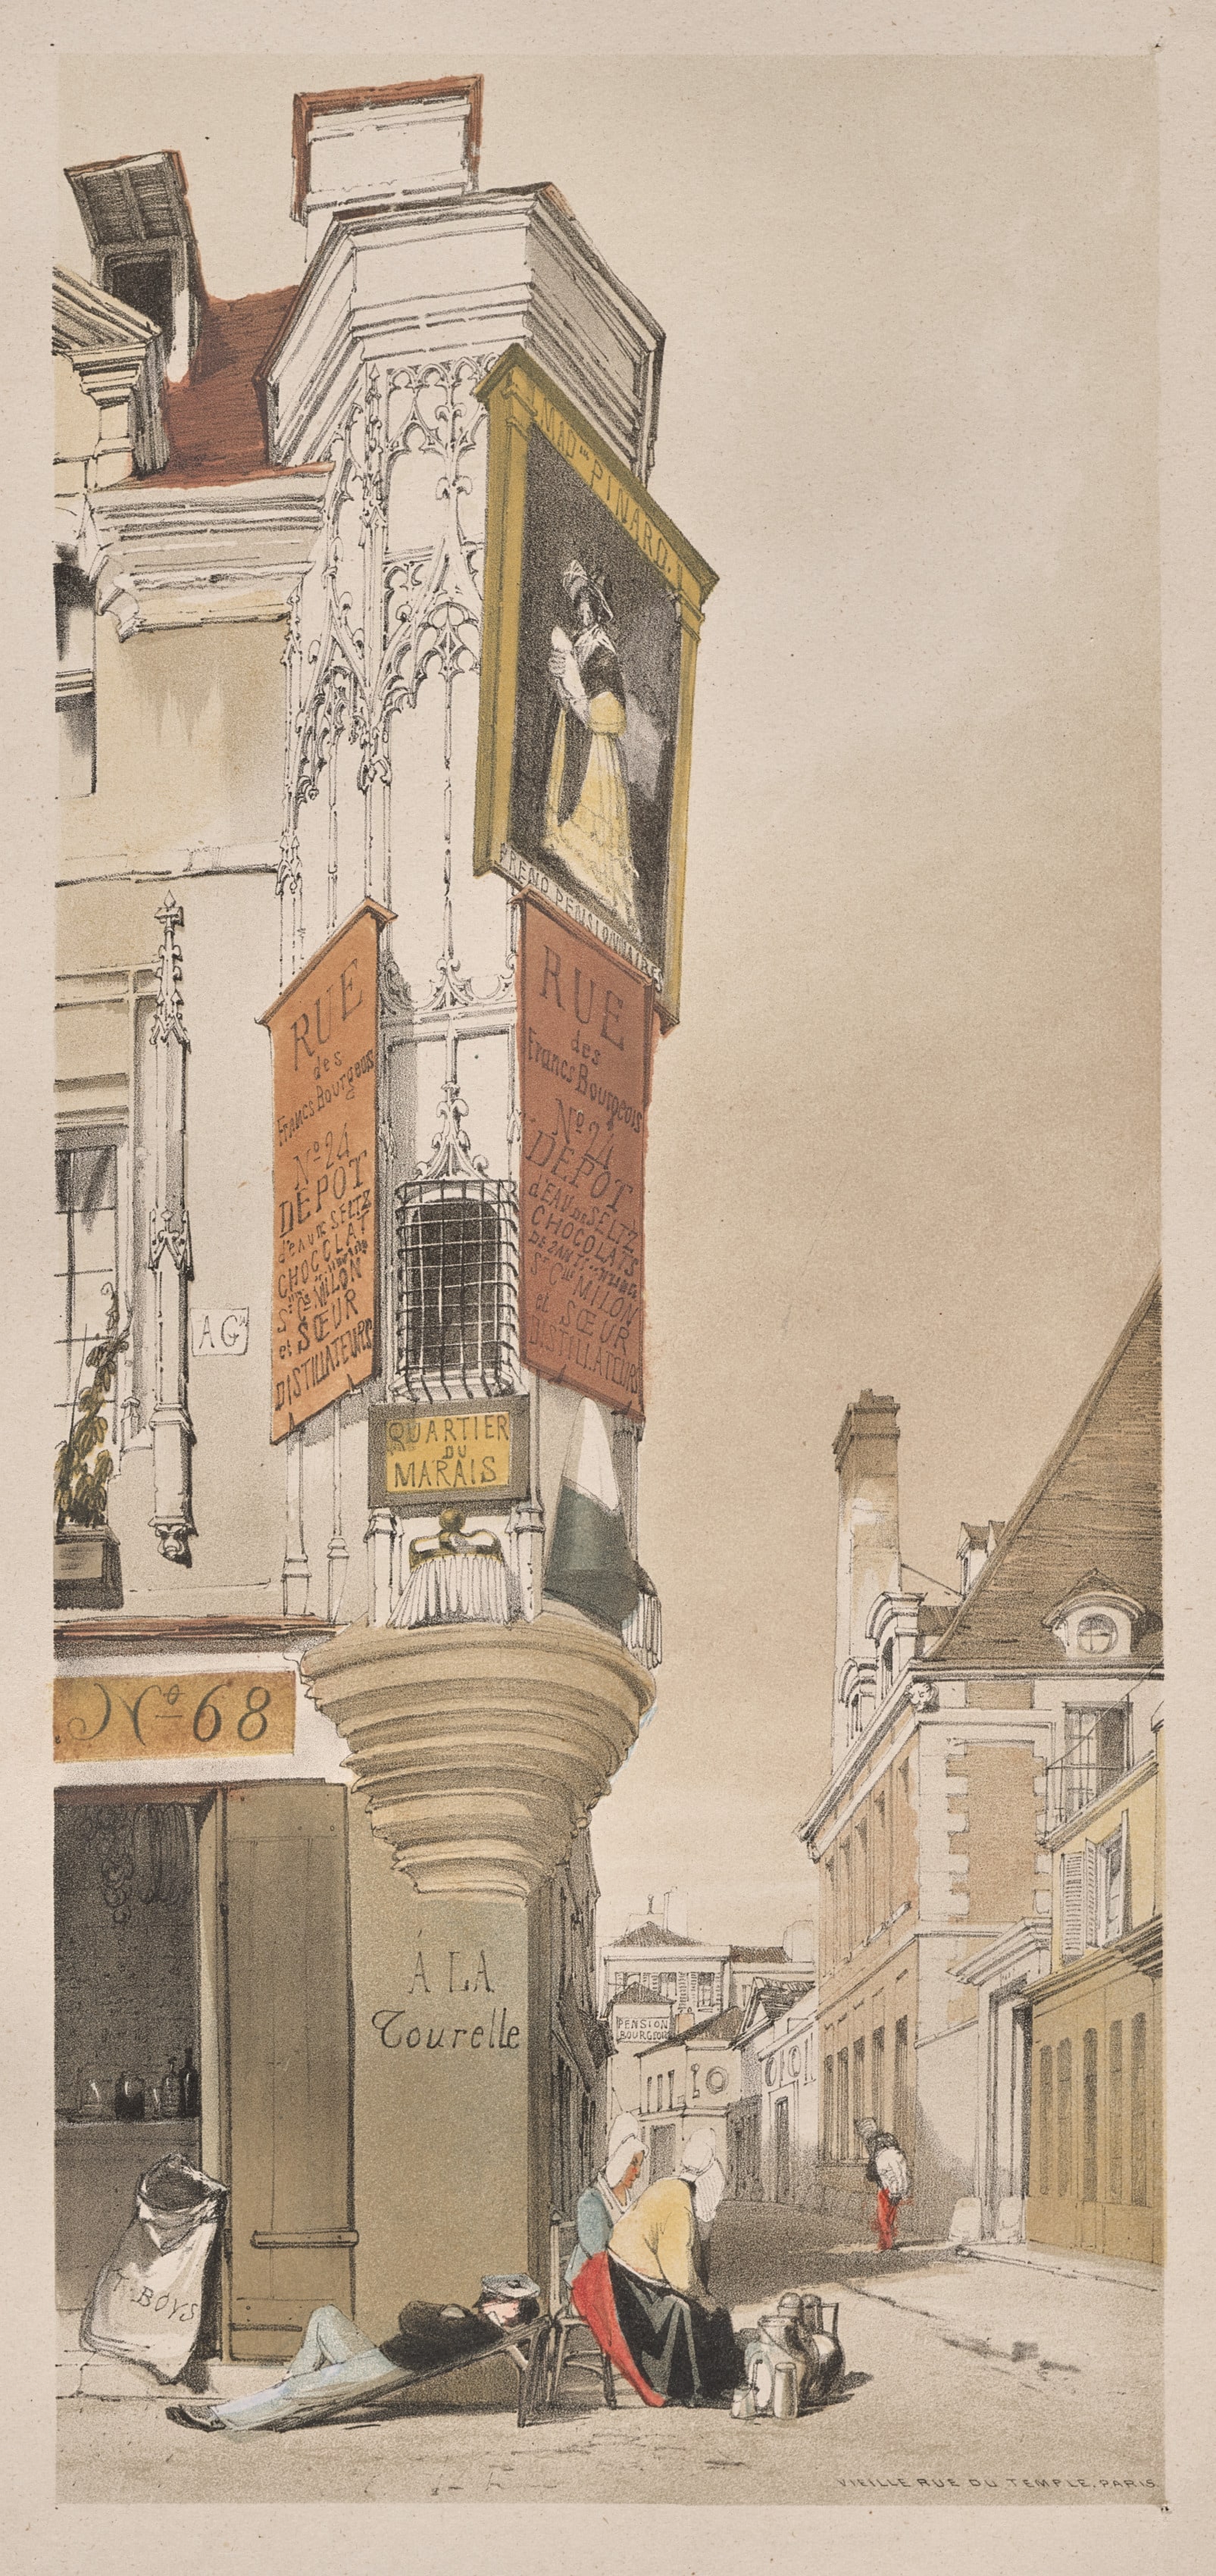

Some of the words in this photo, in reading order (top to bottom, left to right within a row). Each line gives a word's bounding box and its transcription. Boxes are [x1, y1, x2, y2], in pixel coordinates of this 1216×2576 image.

[291, 958, 363, 1071] RUE
[539, 944, 625, 1052] RUE
[313, 1051, 342, 1080] des
[528, 1027, 575, 1083] Francs
[571, 1029, 601, 1066] des
[277, 1100, 314, 1146] Francs
[326, 1122, 349, 1169] 24
[531, 1205, 639, 1277] CHOCOLATS
[536, 1292, 549, 1313] et
[573, 1276, 639, 1327] MILON
[387, 1415, 509, 1452] QUARTIER
[442, 1444, 467, 1459] DU
[394, 1455, 497, 1488] MARAIS
[193, 1683, 271, 1743] 68
[449, 1949, 495, 1993] LA
[371, 2008, 520, 2049] Tourelle
[617, 2018, 668, 2030] PENSION
[131, 2284, 198, 2322] BOYS
[836, 2478, 911, 2488] VIEILLE
[917, 2478, 961, 2488] RUE
[969, 2478, 998, 2488] DU
